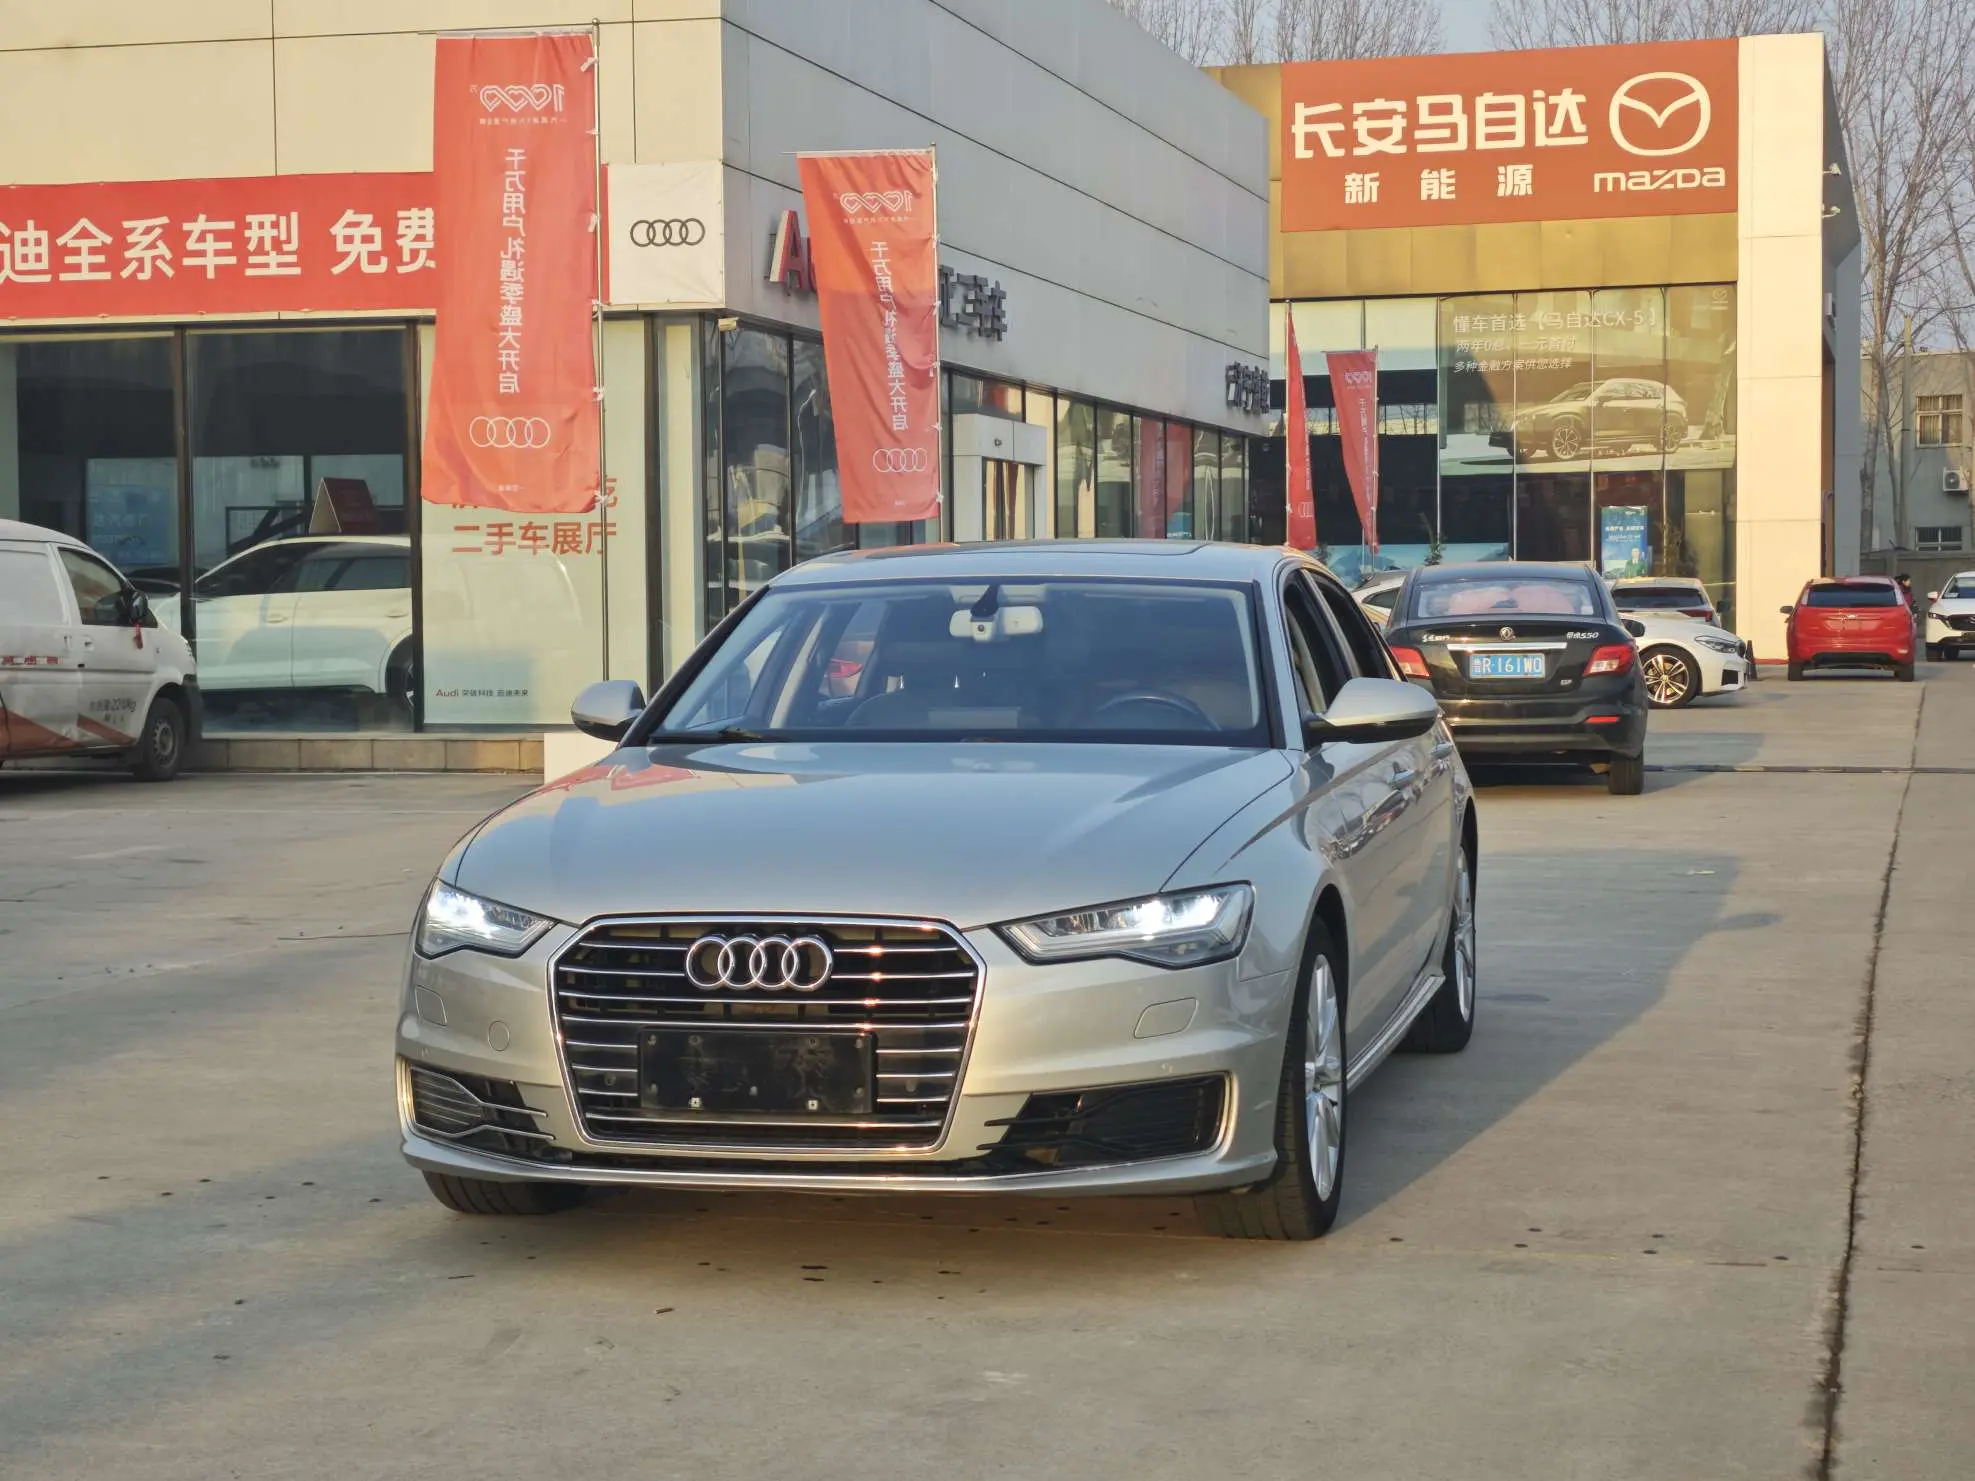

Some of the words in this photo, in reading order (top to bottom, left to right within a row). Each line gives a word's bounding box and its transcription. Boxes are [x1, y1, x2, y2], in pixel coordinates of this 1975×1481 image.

[1290, 87, 1588, 160] 长安马自达
[1344, 163, 1534, 204] 新能源
[0, 210, 303, 285] 迪全系车型
[329, 207, 437, 276] 免费
[1453, 313, 1527, 333] 懂车首选
[451, 520, 618, 556] 二手车展厅
[435, 688, 459, 697] Audi
